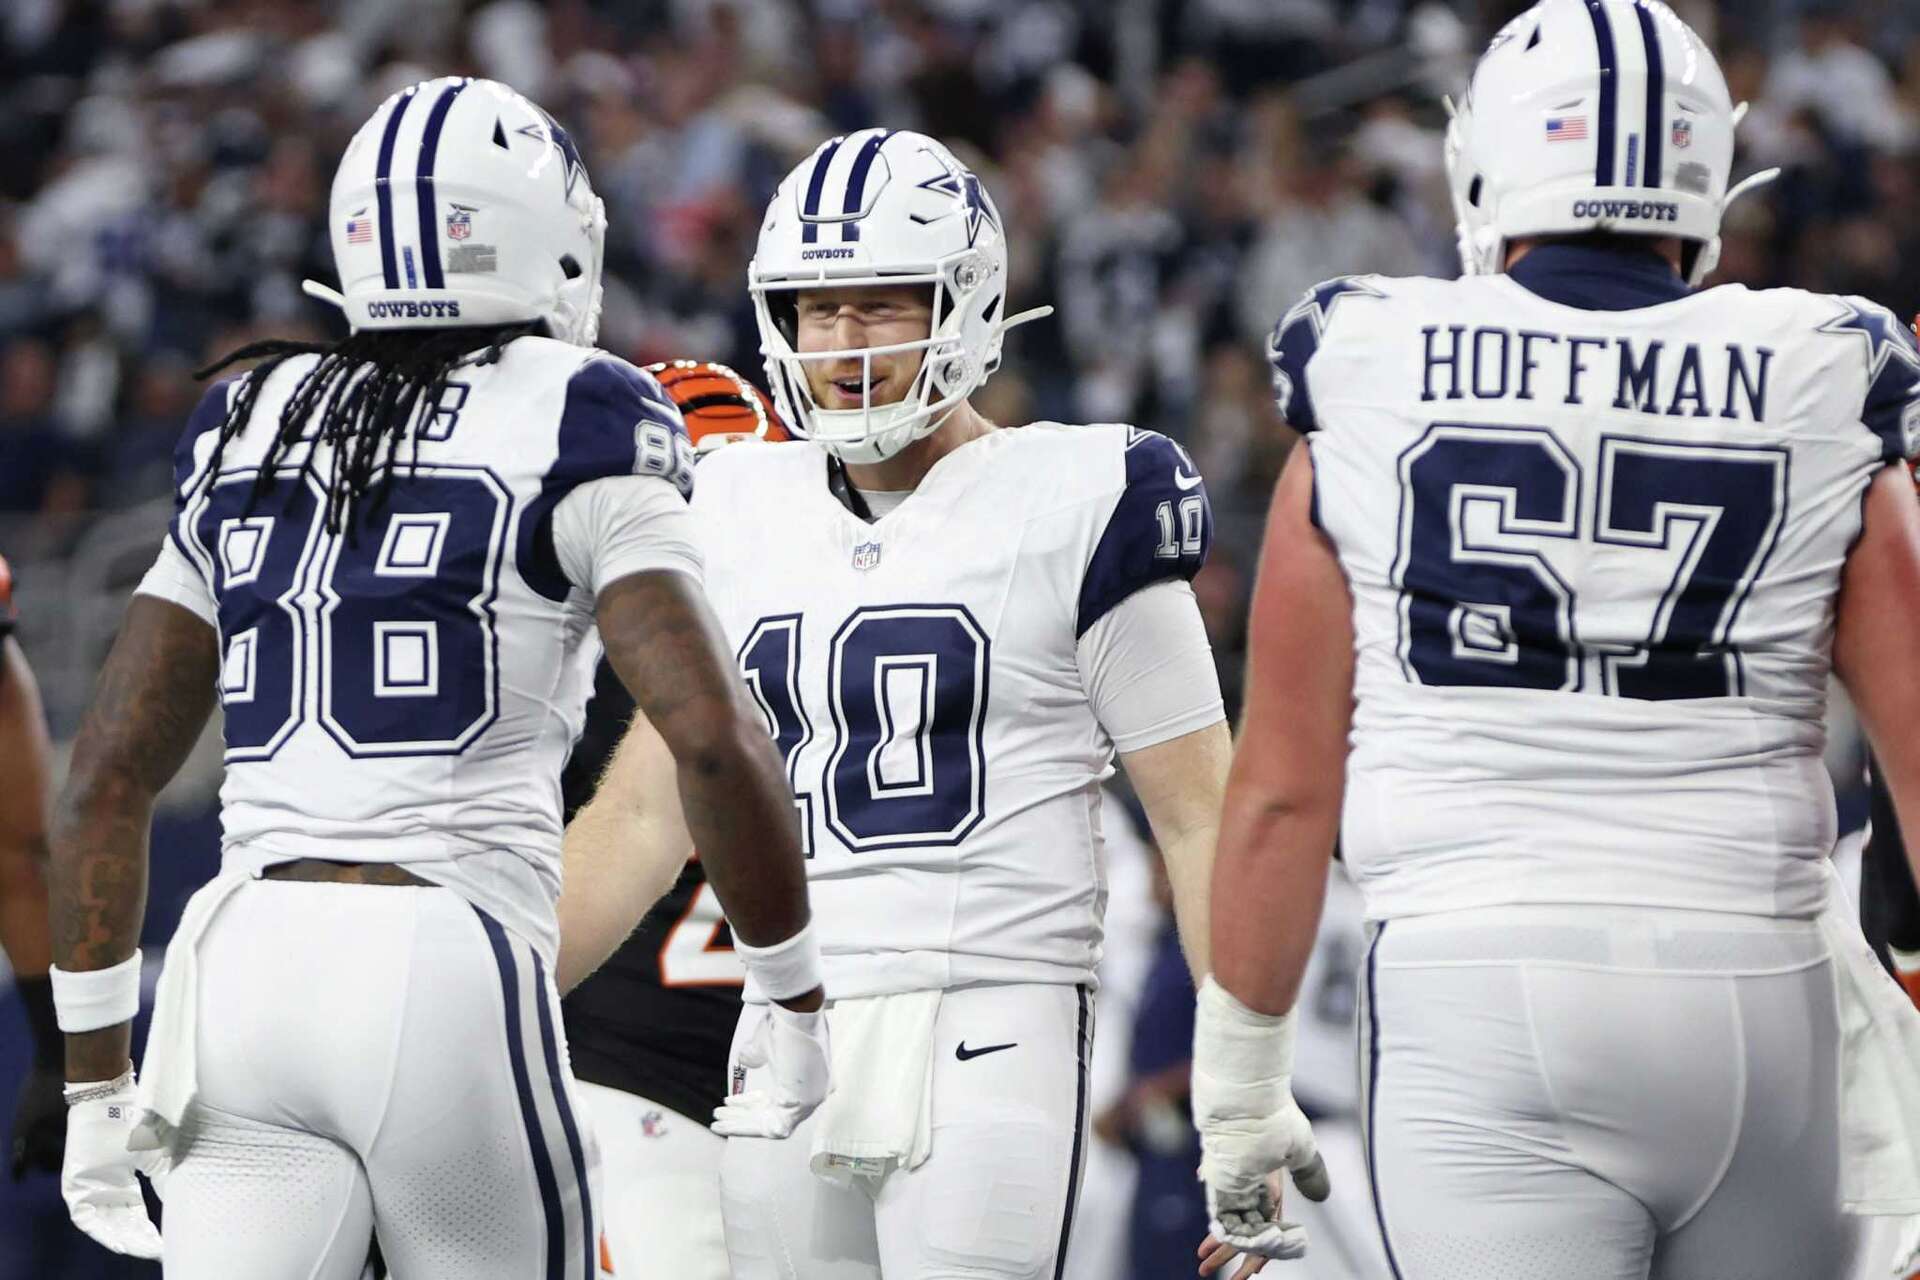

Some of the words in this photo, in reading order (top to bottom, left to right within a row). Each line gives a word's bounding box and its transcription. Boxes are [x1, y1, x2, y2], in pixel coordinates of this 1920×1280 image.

[449, 224, 470, 238] NFL
[1573, 200, 1678, 221] COWBOYS
[802, 248, 855, 260] COWBOYS
[368, 300, 461, 318] COWBOYS
[1420, 325, 1775, 422] HOFFMAN
[1154, 495, 1203, 558] 10
[855, 552, 879, 569] NFL
[1390, 422, 1792, 701] 67
[188, 462, 514, 767] 88
[736, 603, 992, 860] 10
